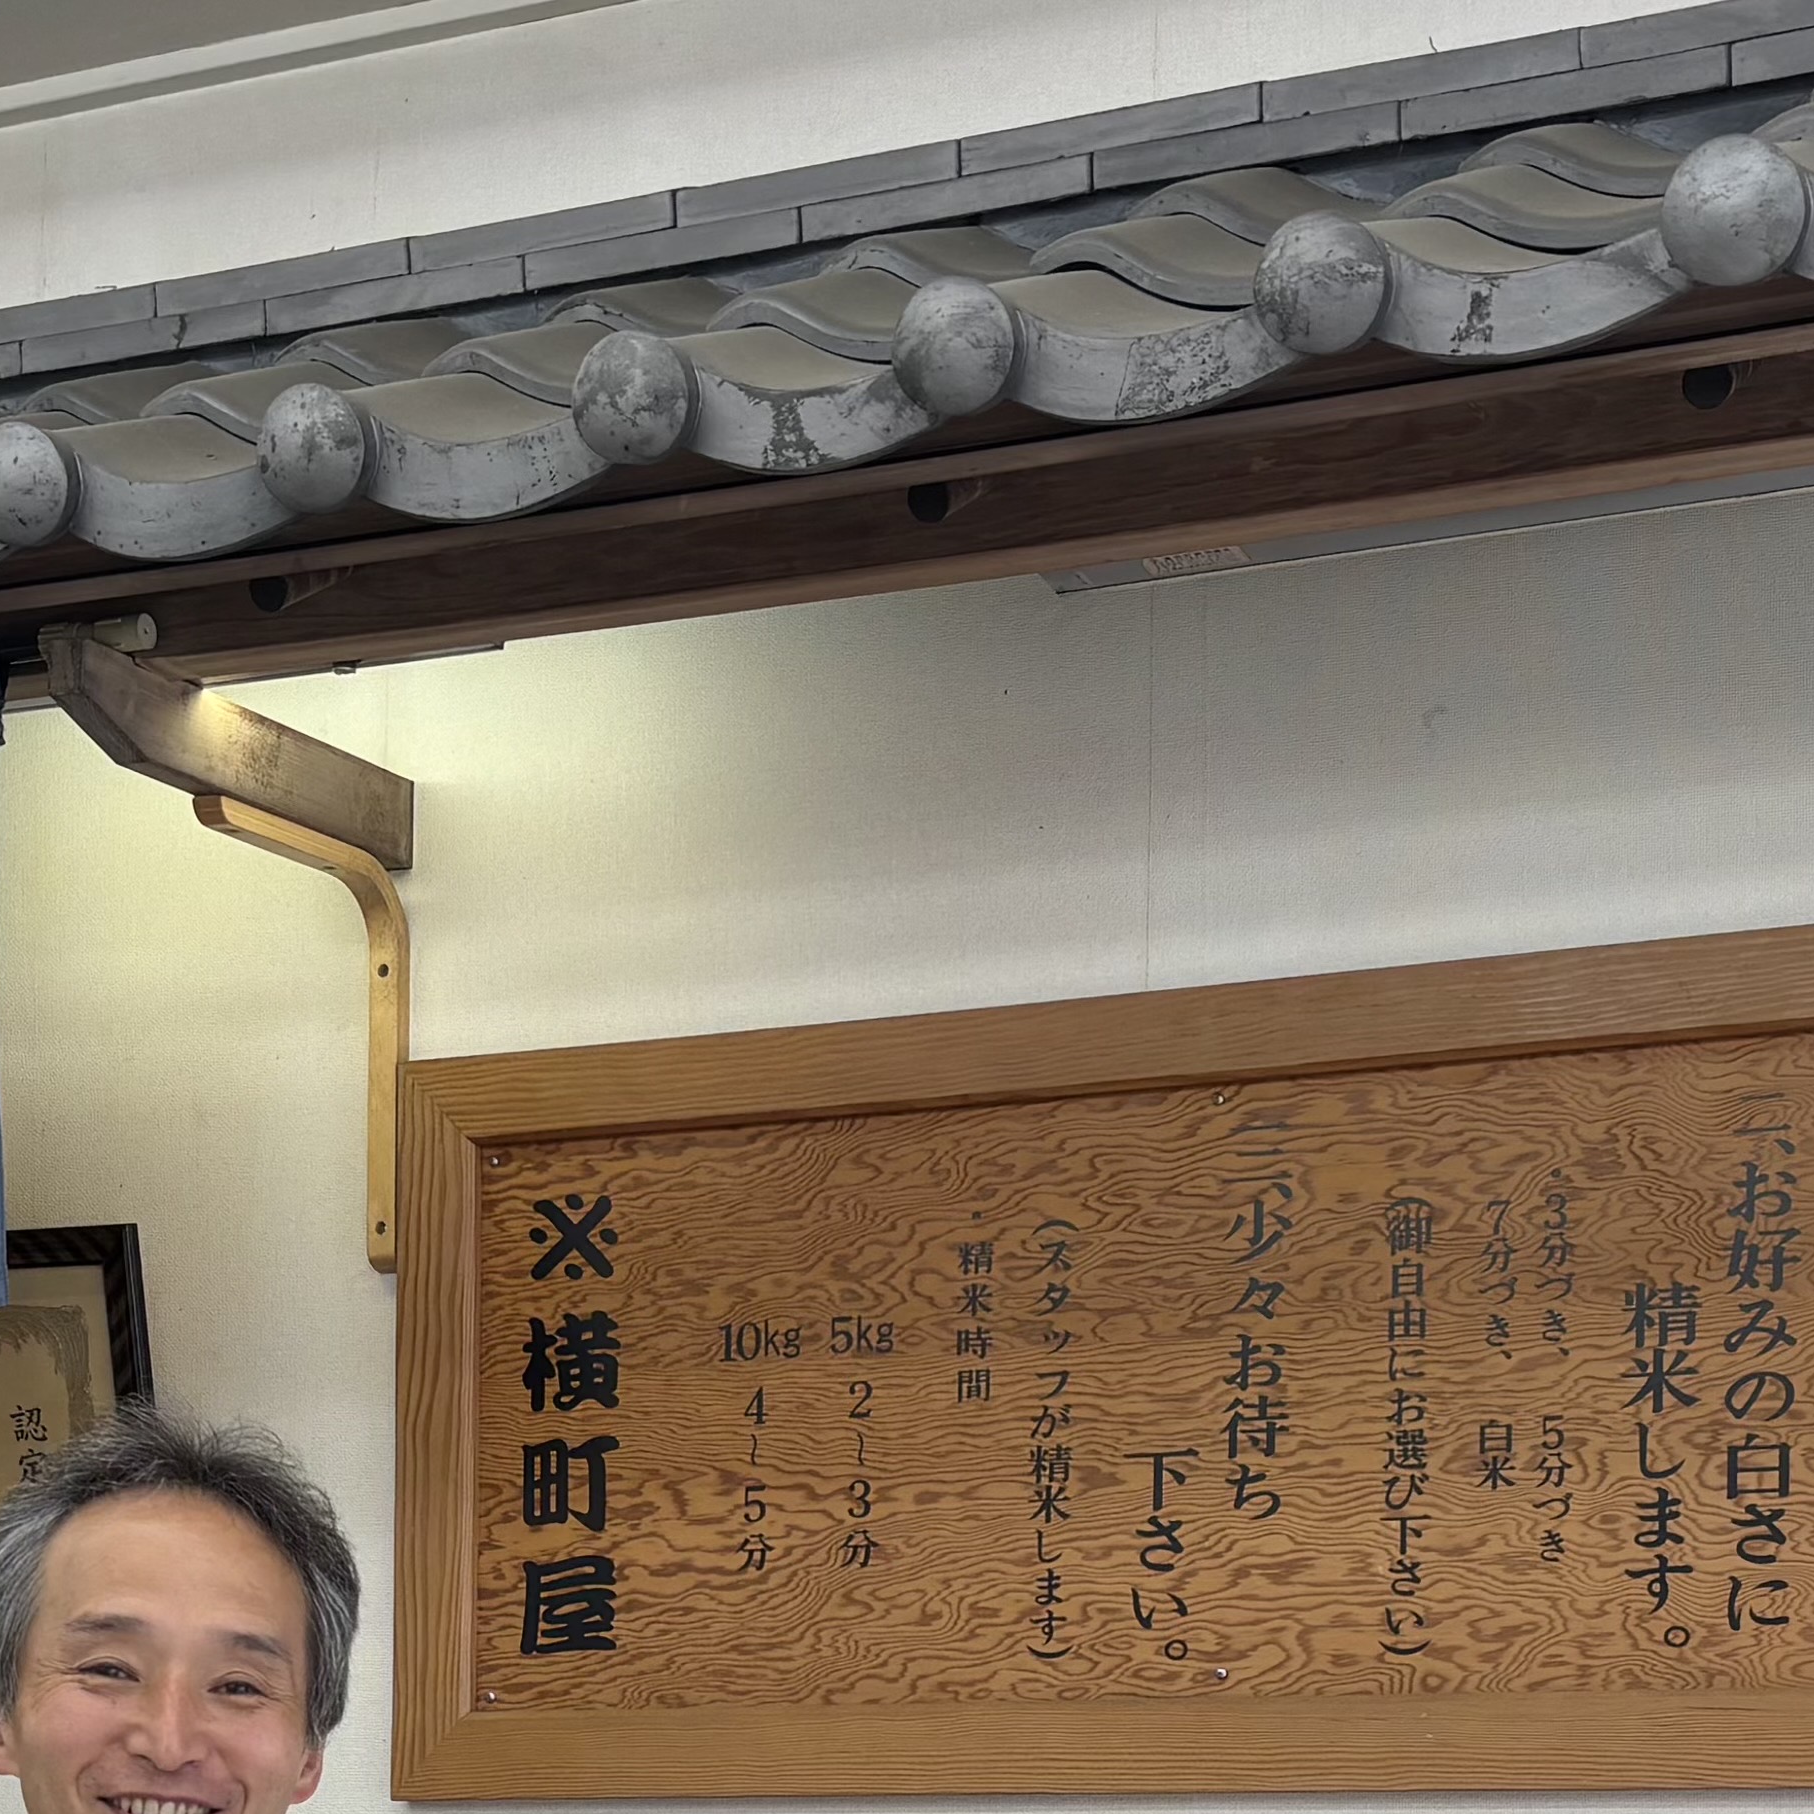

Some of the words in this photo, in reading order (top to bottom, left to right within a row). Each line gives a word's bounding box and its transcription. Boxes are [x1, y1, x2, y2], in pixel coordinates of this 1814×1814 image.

[717, 1320, 803, 1364] 10kg
[829, 1316, 897, 1356] 5kg
[1027, 1217, 1080, 1660] （スタッフが精米します）
[1620, 1280, 1703, 1649] 精米します。
[1723, 1091, 1802, 1632] 二、お好みの白さに
[1121, 1448, 1199, 1661] 下さい。
